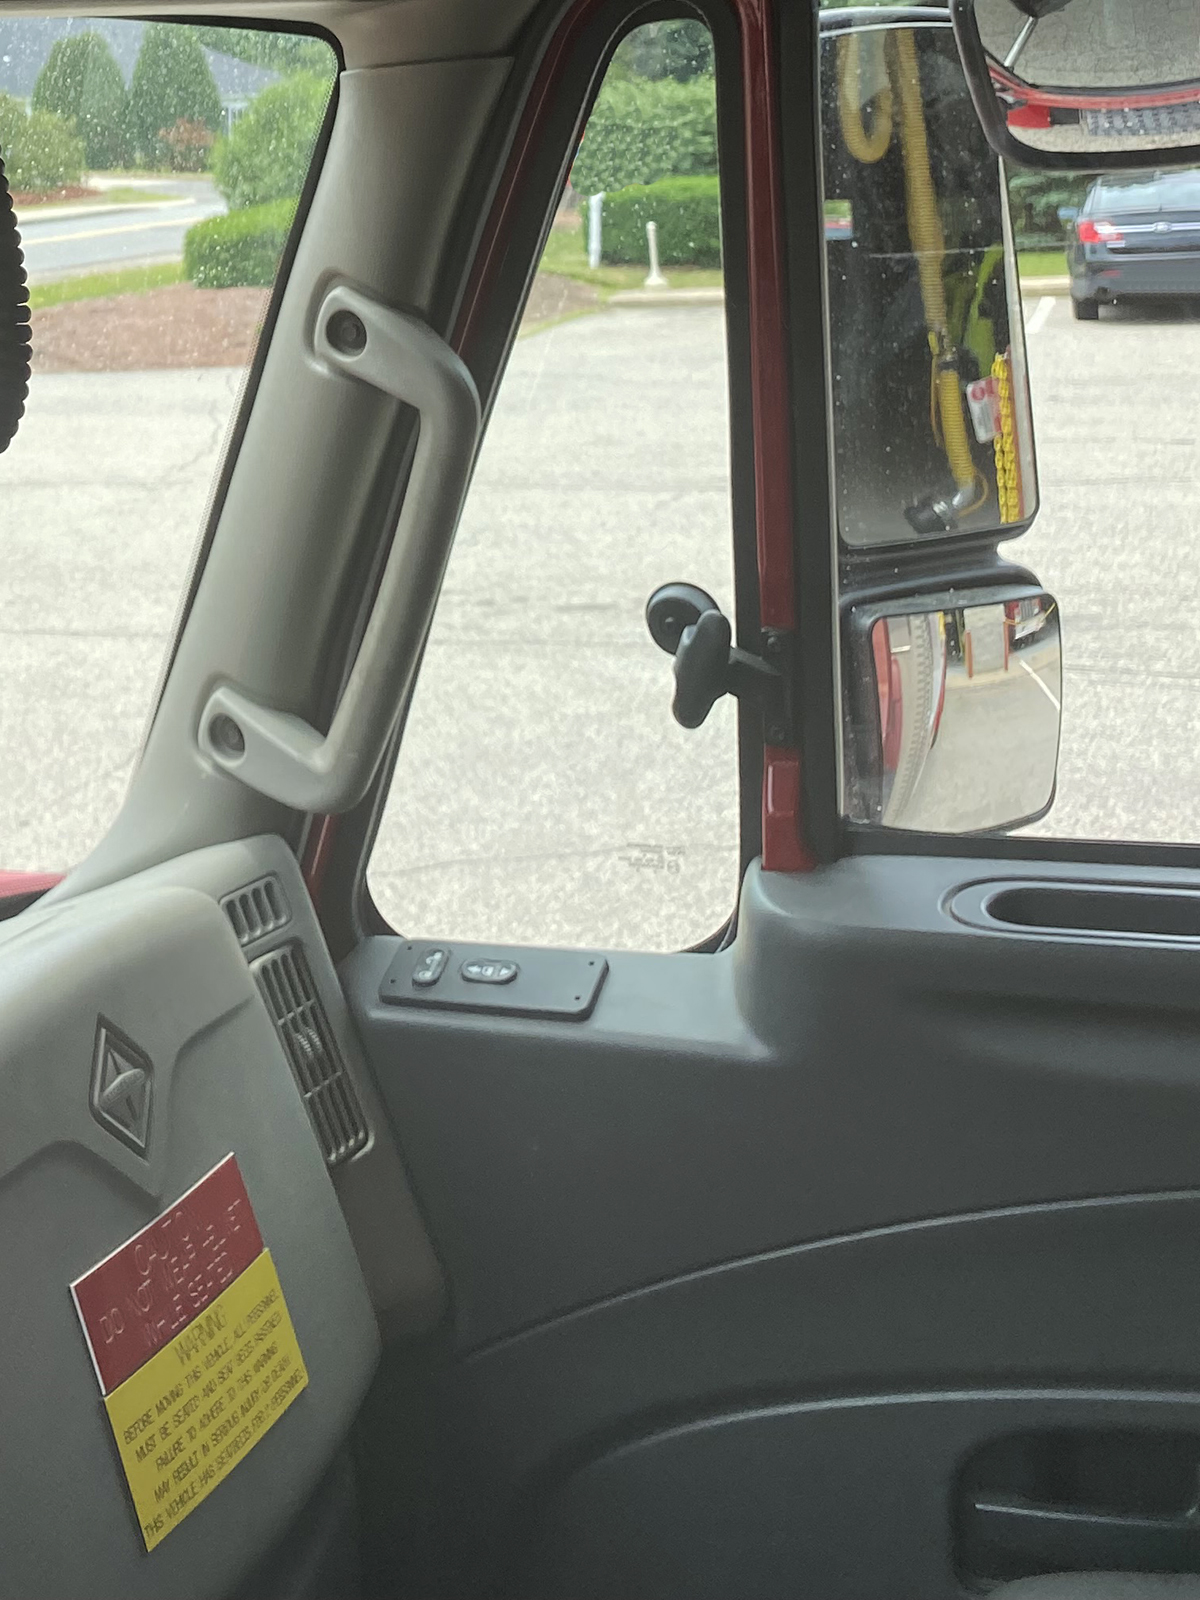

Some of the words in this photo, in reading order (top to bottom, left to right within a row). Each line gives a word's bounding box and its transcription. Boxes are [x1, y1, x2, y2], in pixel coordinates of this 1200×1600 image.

[142, 1291, 187, 1349] WHLE
[173, 1300, 228, 1369] WARNING
[184, 1363, 201, 1389] THIS
[135, 1433, 157, 1464] MUST
[158, 1419, 171, 1442] BE
[185, 1423, 197, 1444] TO
[153, 1476, 172, 1504] MAY
[200, 1438, 211, 1458] IN
[143, 1510, 165, 1543] THIS
